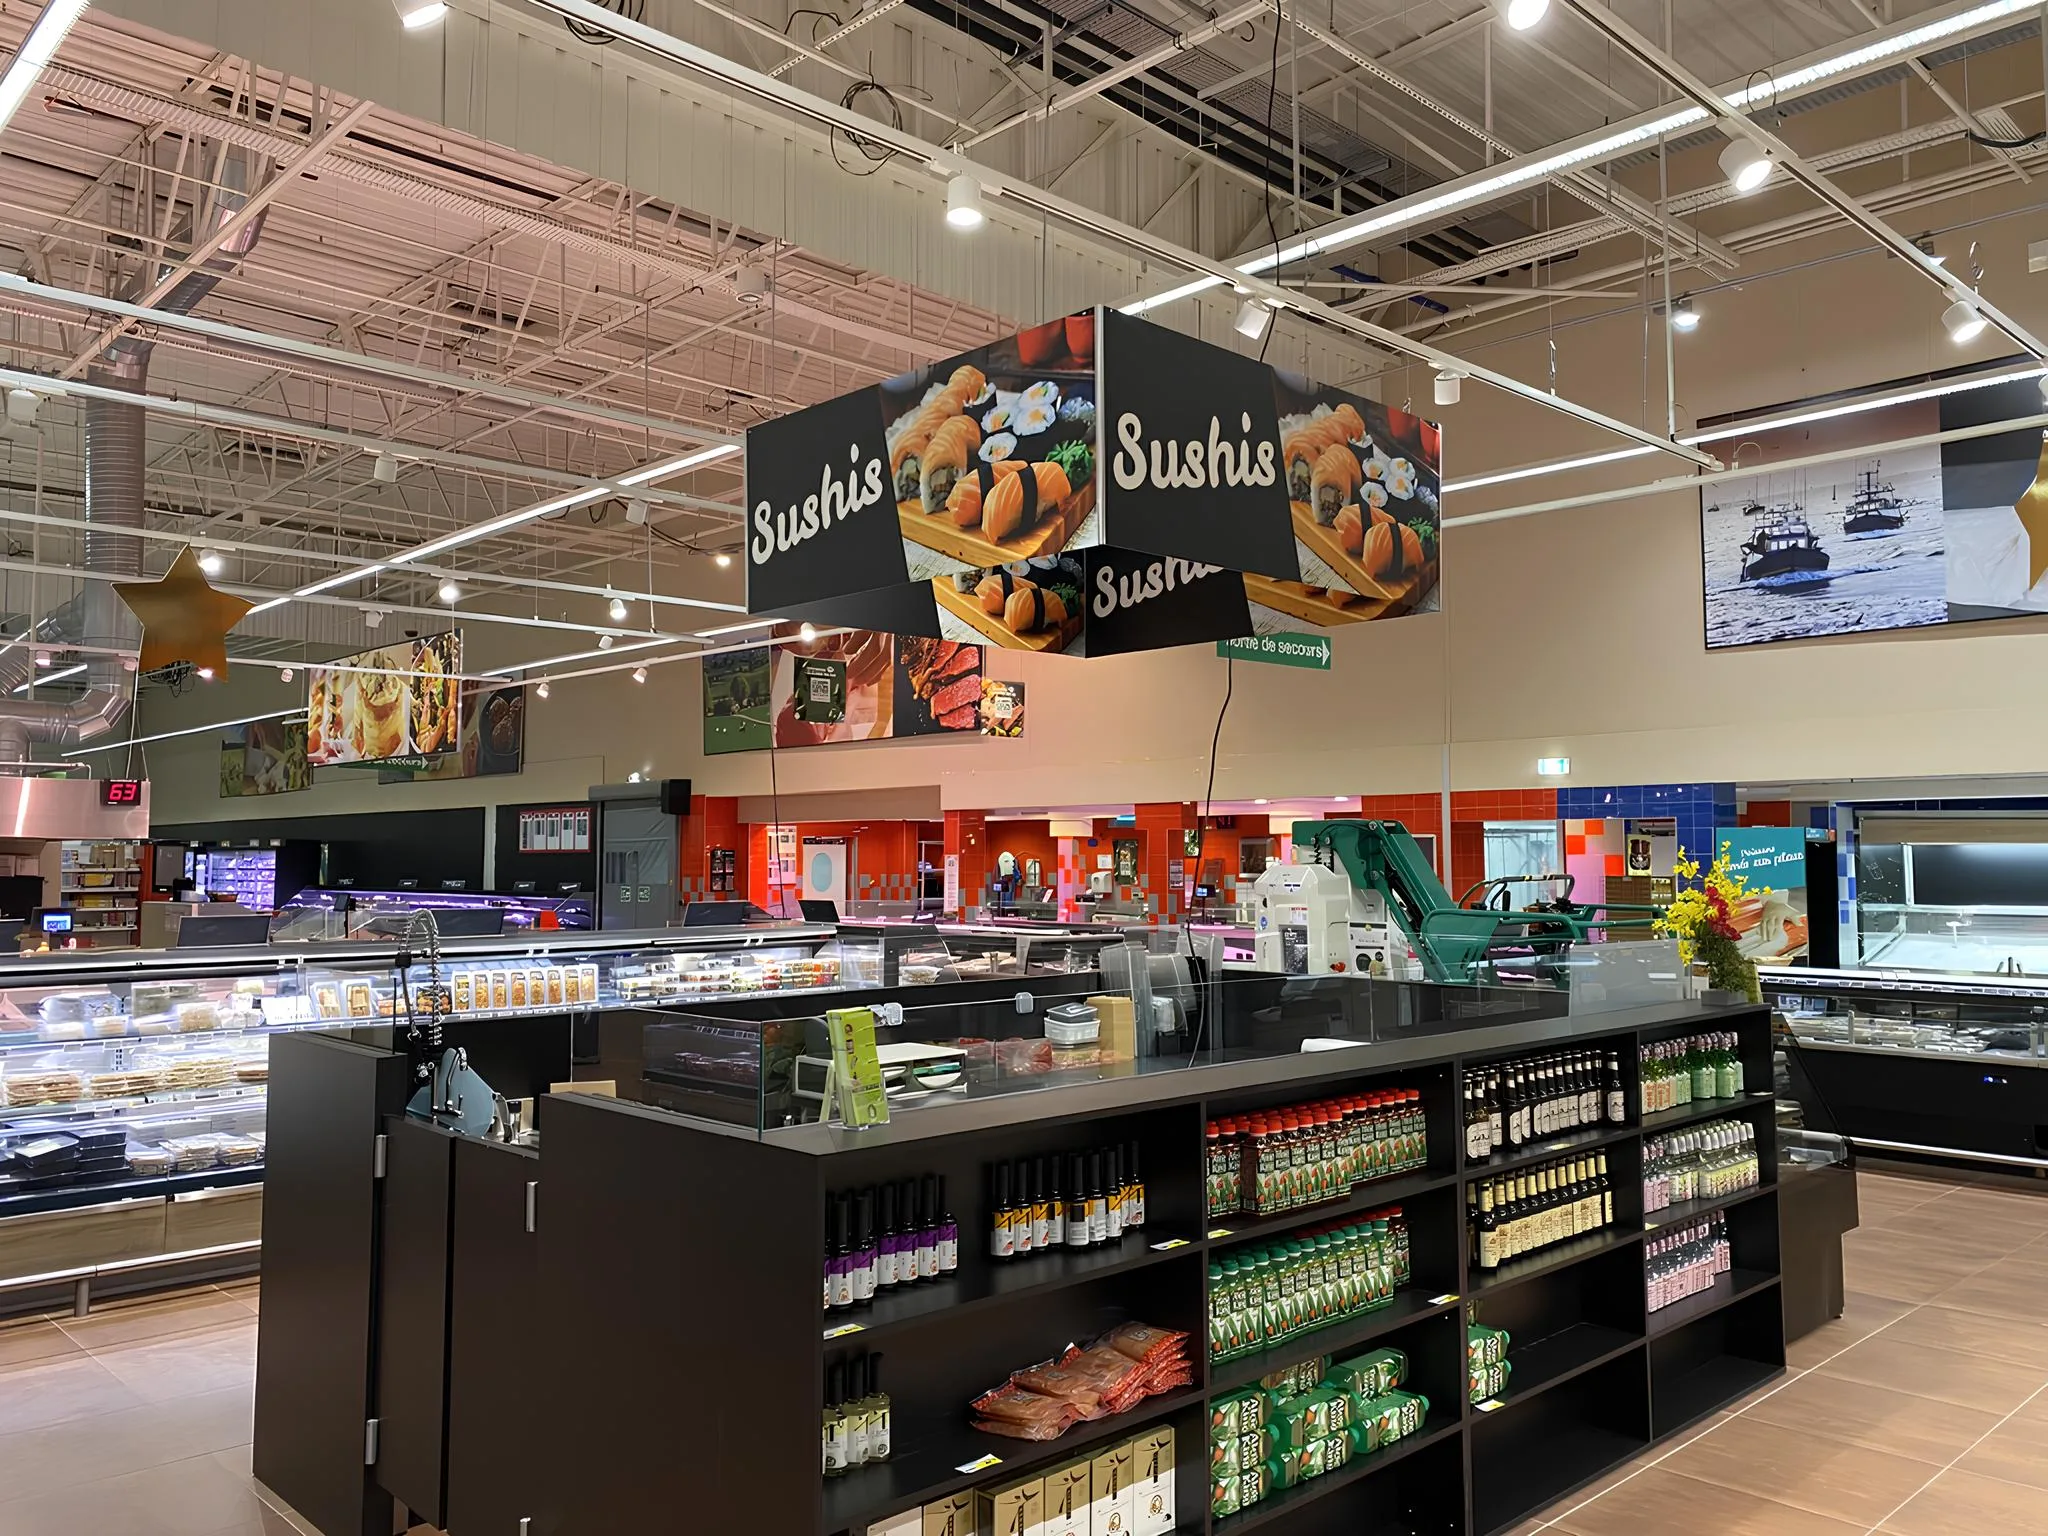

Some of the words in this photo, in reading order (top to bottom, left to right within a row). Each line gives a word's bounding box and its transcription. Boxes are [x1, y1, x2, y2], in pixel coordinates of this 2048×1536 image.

[1113, 411, 1276, 490] Sushis
[751, 442, 884, 565] Sushis
[1261, 636, 1276, 653] de
[1277, 641, 1323, 659] secours
[110, 783, 137, 801] 63
